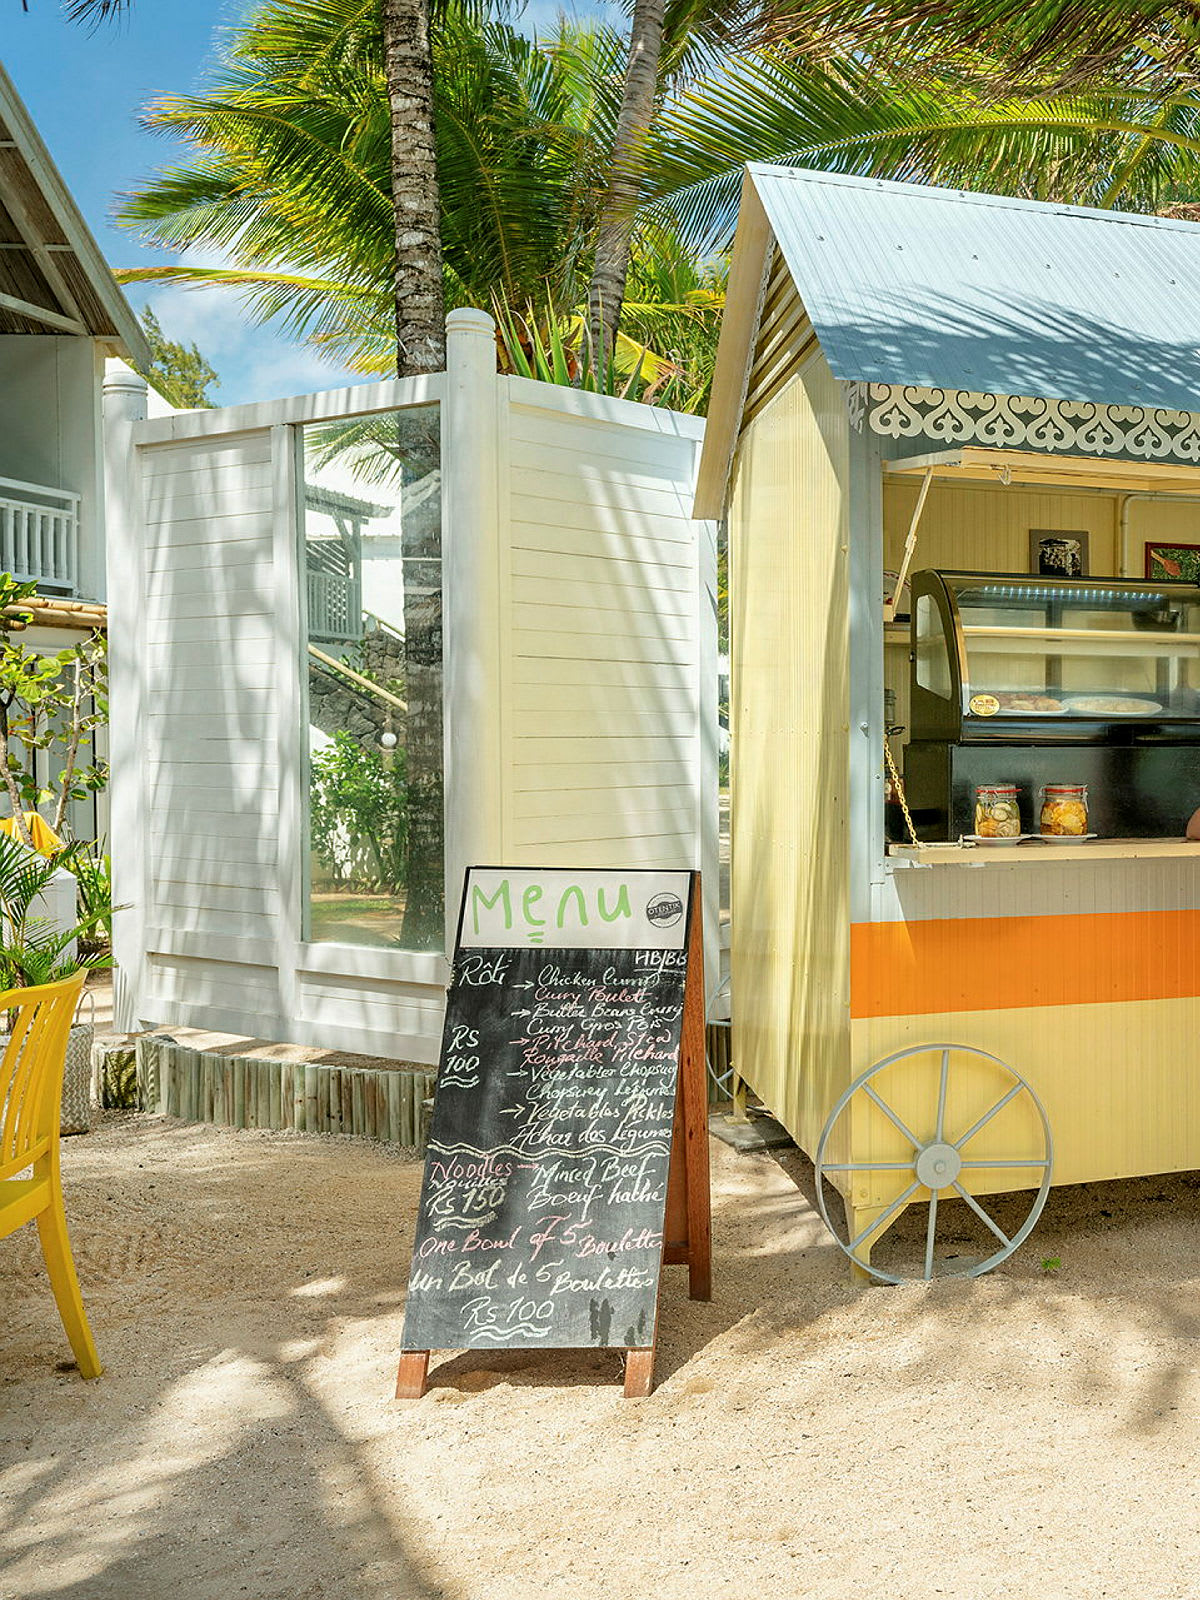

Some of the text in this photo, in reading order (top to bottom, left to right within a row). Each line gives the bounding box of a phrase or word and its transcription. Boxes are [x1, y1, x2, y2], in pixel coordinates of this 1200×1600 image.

[472, 879, 632, 936] Menu
[537, 963, 597, 988] Chicken
[534, 986, 582, 1008] Curry
[527, 1018, 575, 1042] Curry
[626, 1015, 662, 1032] Pois
[444, 1055, 480, 1074] 100
[509, 1120, 573, 1150] Achar
[430, 1152, 657, 1195] Noodles Minced Beef
[462, 1186, 506, 1213] 150
[419, 1236, 458, 1258] One
[461, 1225, 523, 1252] Bowl
[559, 1218, 593, 1245] 5
[448, 1258, 503, 1293] Bol
[507, 1261, 529, 1289] de
[535, 1258, 565, 1283] 5
[507, 1296, 556, 1321] 100
